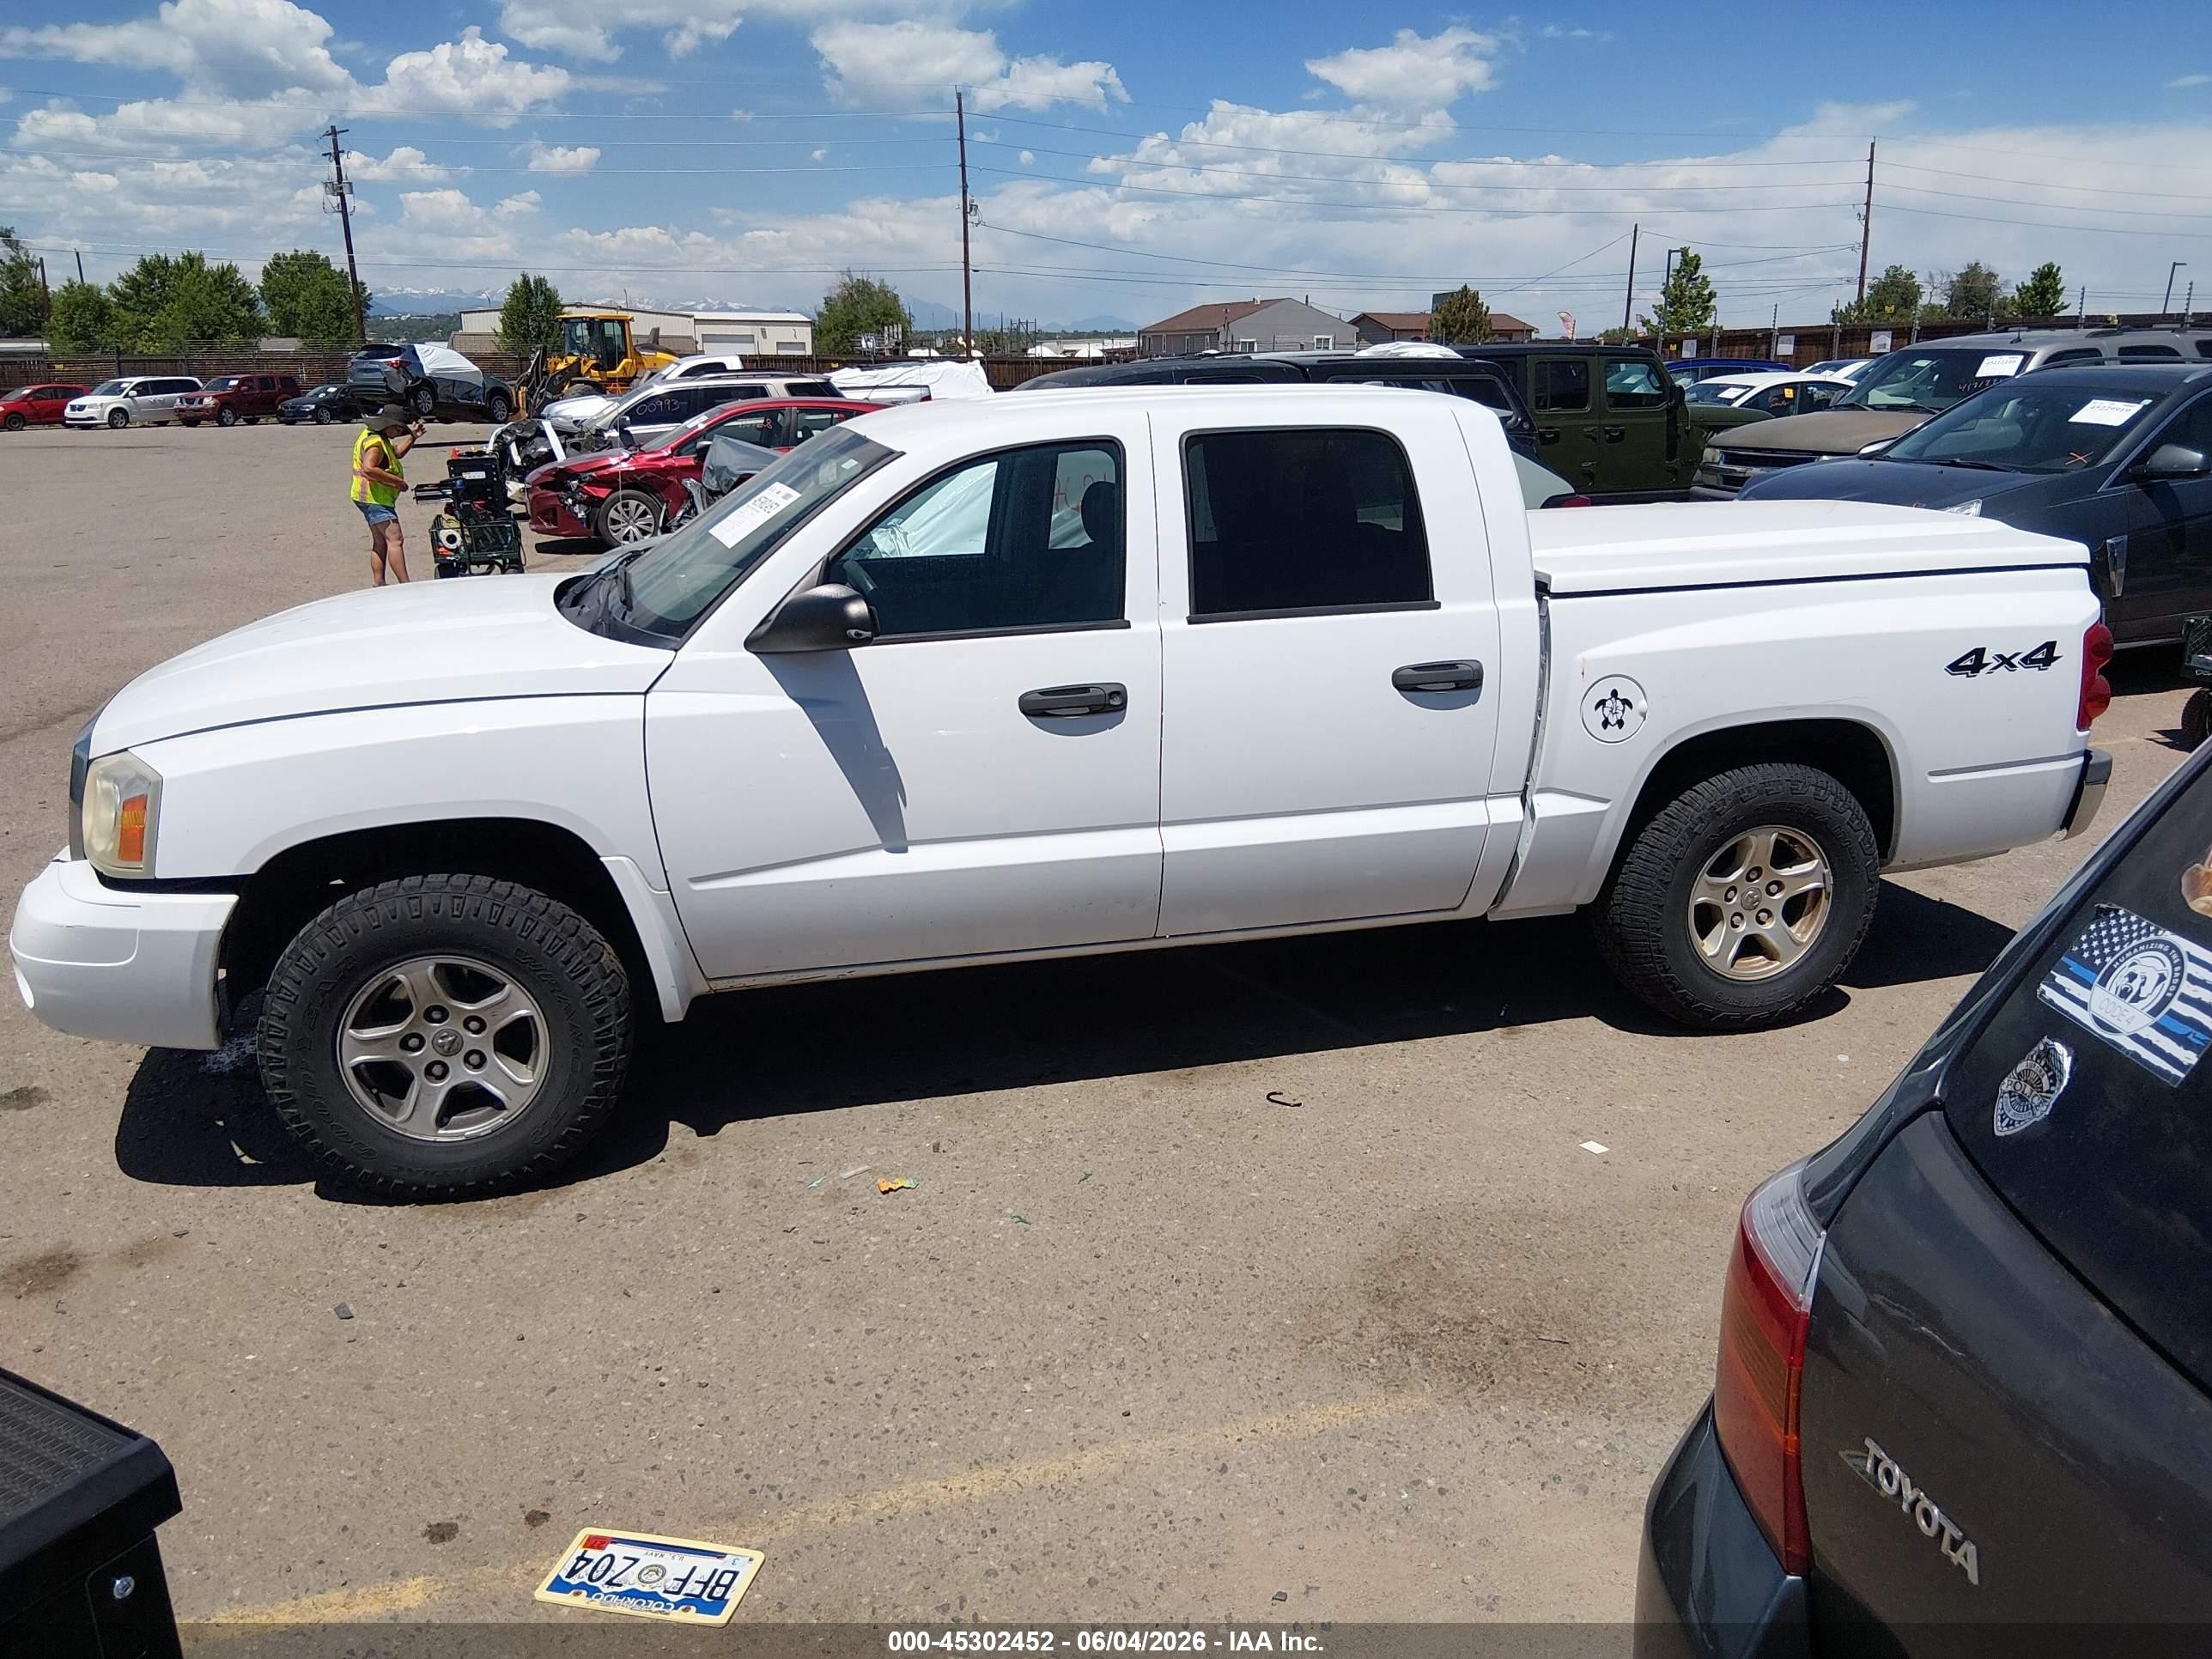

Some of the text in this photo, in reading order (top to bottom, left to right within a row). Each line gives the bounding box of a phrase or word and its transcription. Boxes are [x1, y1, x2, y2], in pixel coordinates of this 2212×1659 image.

[635, 398, 681, 416] 00993
[1944, 640, 2064, 678] 4x4
[2112, 942, 2170, 969] HUMANIZING
[2166, 963, 2184, 998] BADGE
[2098, 998, 2134, 1027] CODE 4
[1864, 1436, 1979, 1586] TOYOTA
[588, 1540, 606, 1548] 27
[663, 1565, 740, 1600] BFF
[591, 1592, 675, 1612] COLORADO
